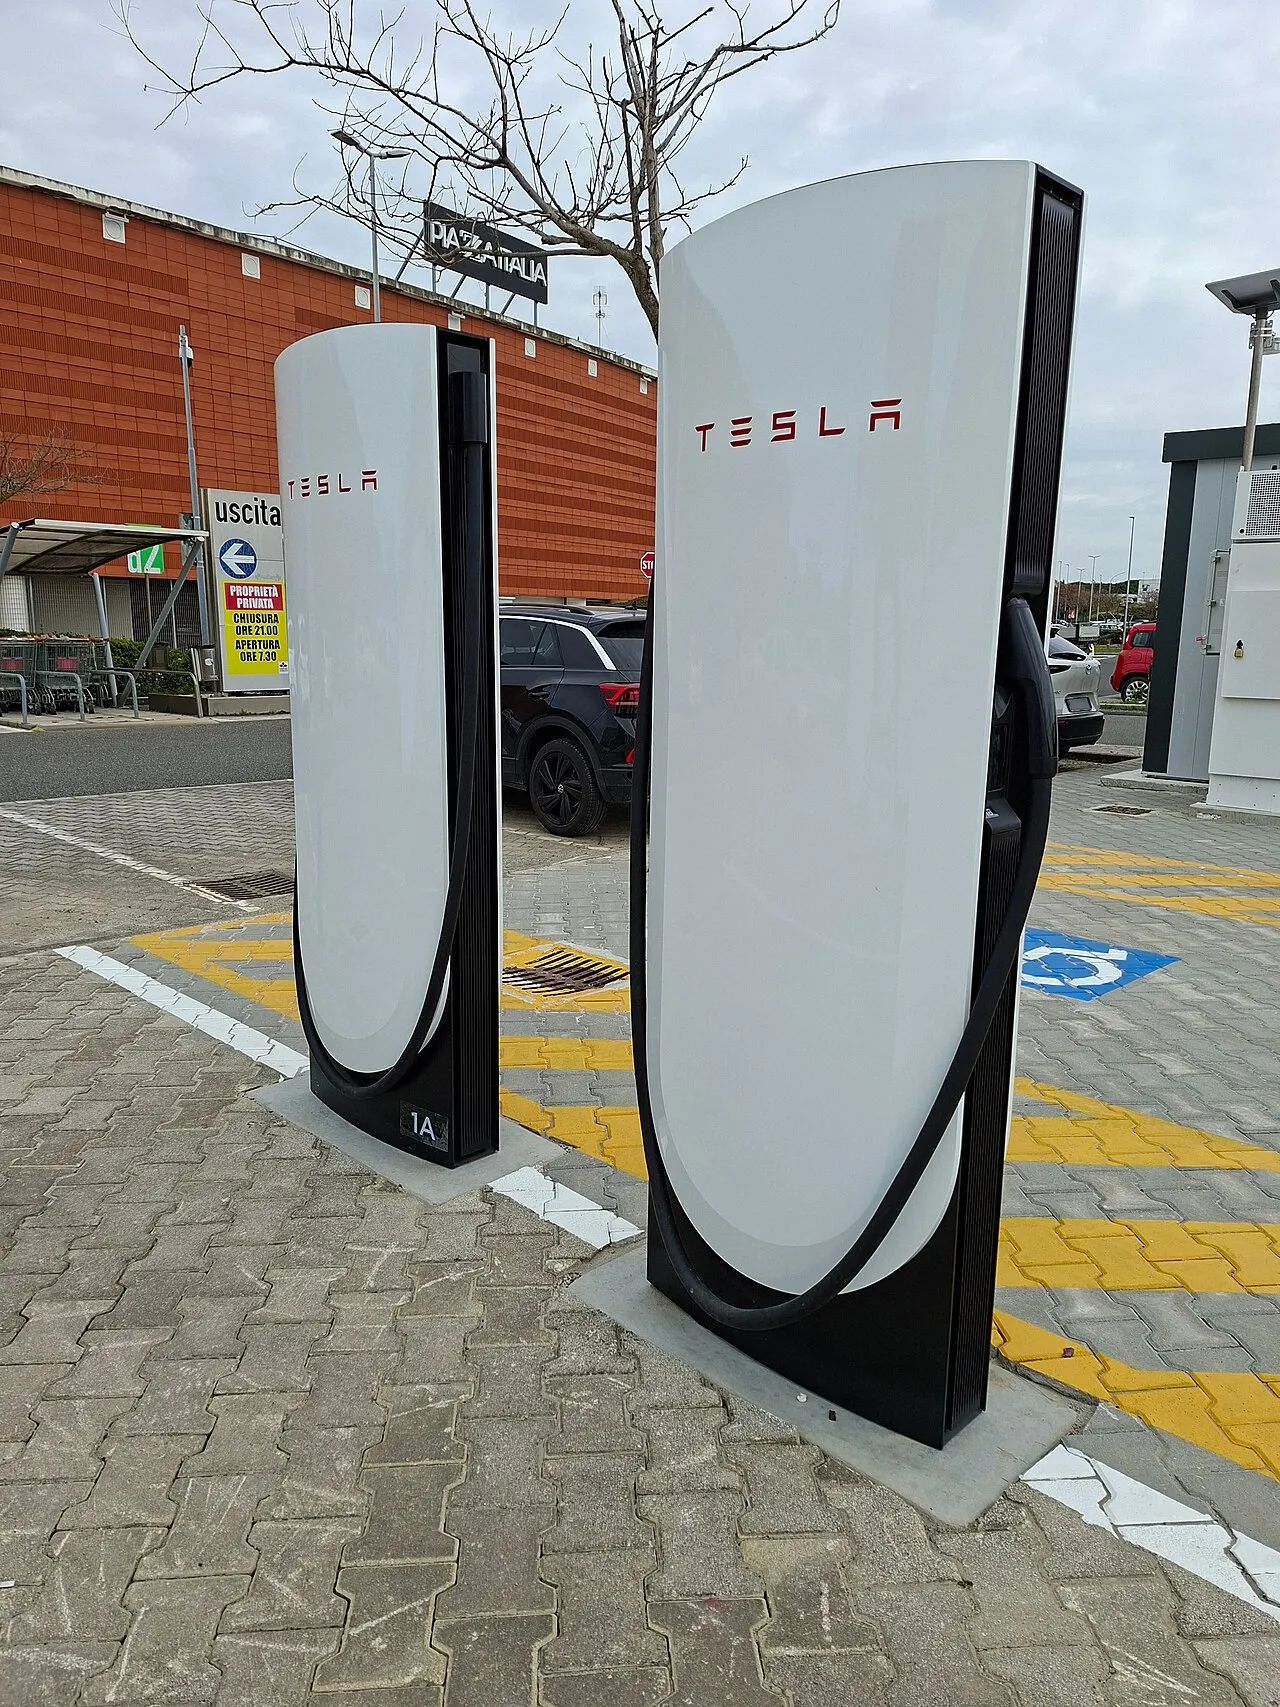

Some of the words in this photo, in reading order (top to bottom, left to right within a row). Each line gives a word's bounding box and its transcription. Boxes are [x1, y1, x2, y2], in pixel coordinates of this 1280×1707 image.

[694, 397, 903, 453] TESLA
[287, 470, 379, 500] TESLA
[215, 496, 281, 527] uscita
[229, 584, 279, 598] PROPRIETÀ
[236, 597, 274, 609] PRIVATA
[233, 613, 279, 624] CHIUSURA
[235, 625, 253, 636] ORE
[254, 625, 278, 636] 21.00
[235, 639, 280, 650] APERTURA
[240, 651, 257, 662] ORE
[258, 651, 277, 662] 7.30
[411, 1111, 436, 1141] 1A
